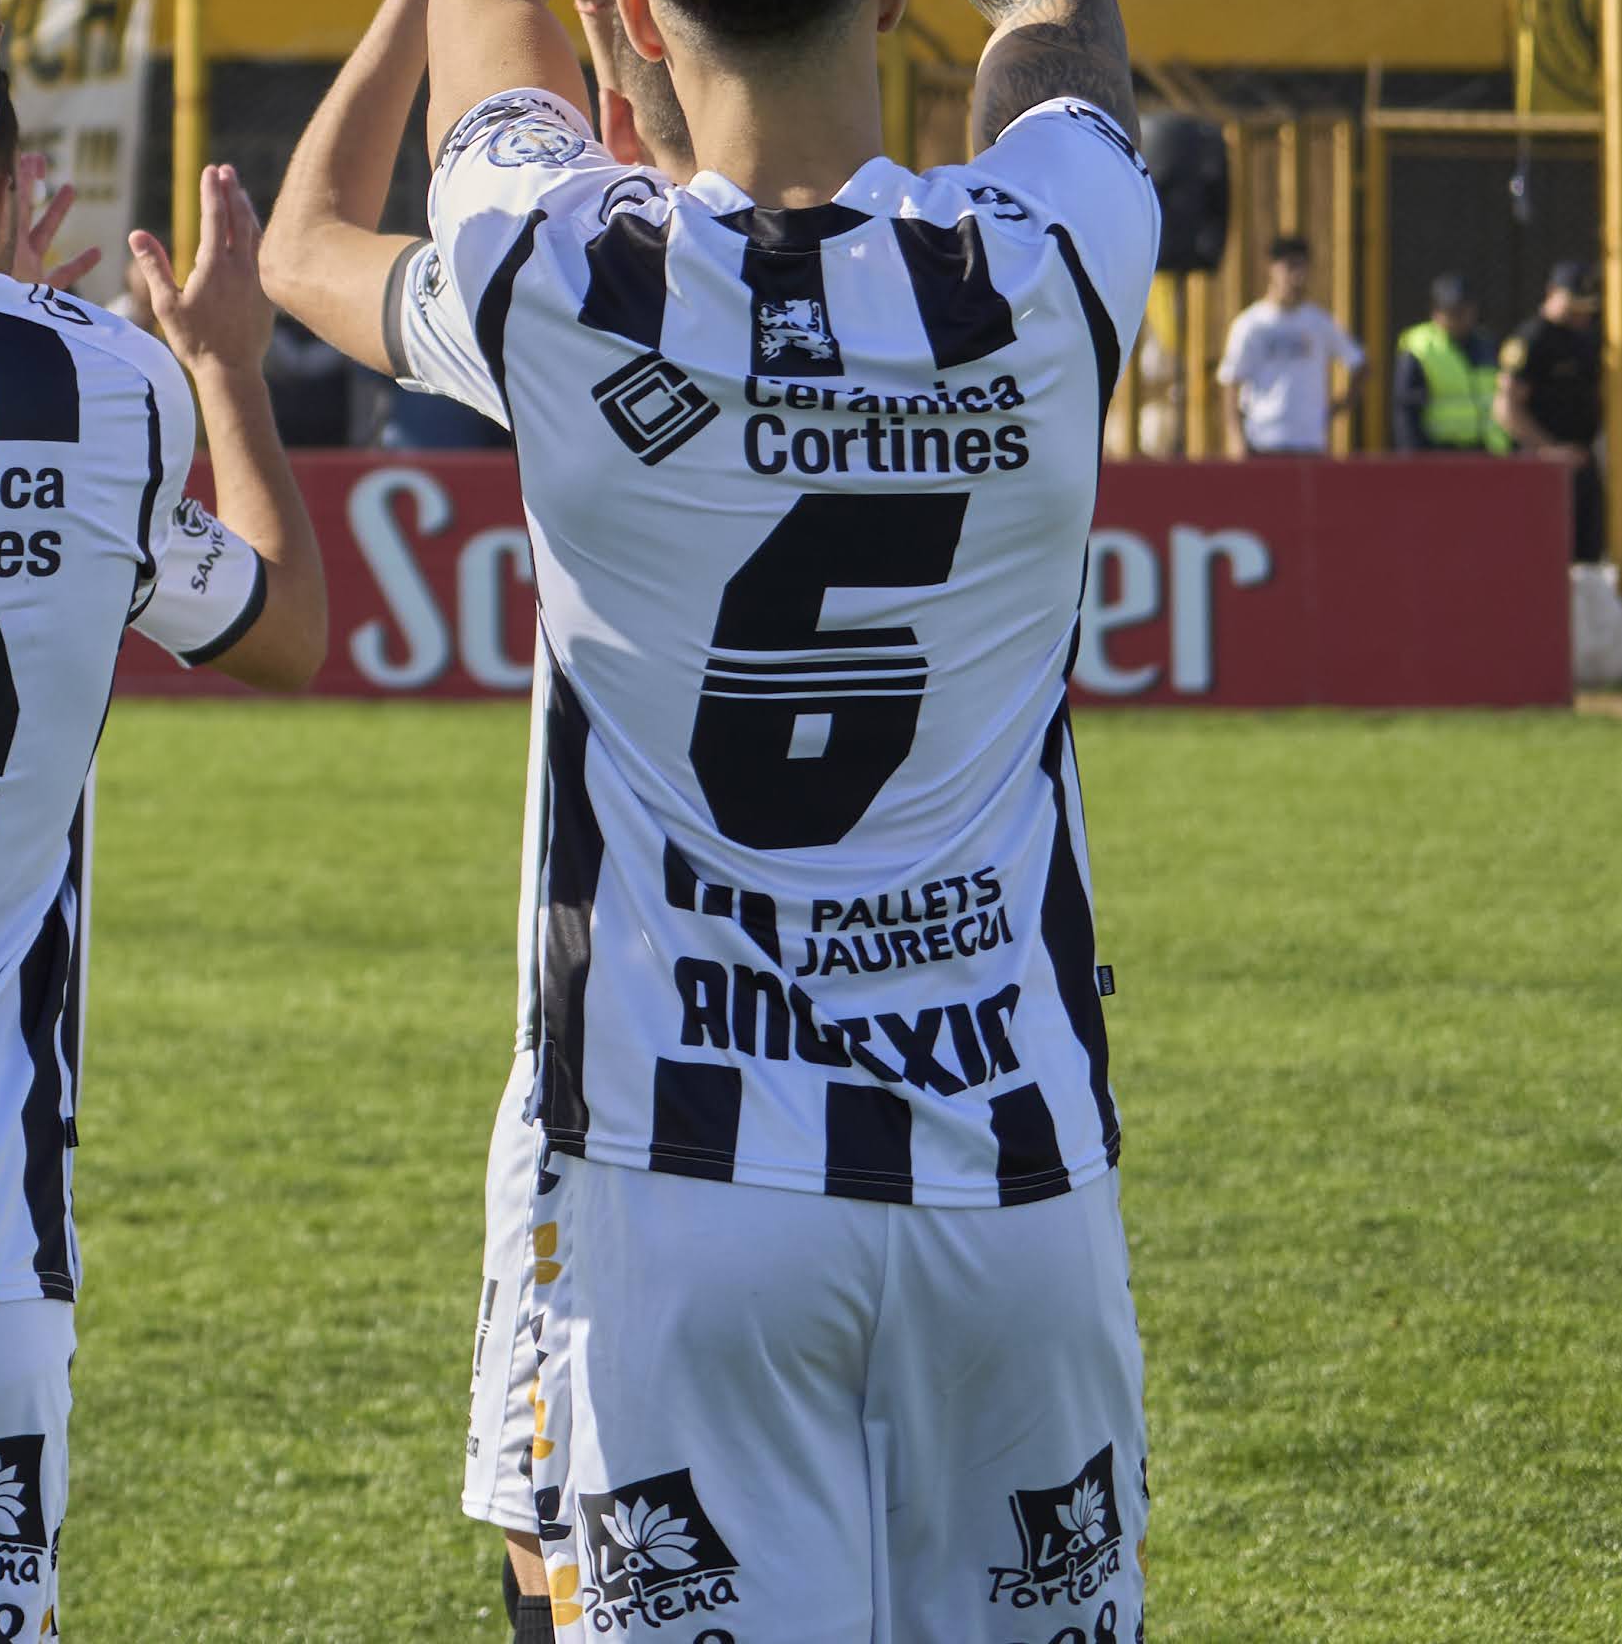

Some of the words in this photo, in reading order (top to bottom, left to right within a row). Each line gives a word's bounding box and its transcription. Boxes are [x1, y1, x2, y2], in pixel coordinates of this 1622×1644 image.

[744, 413, 1030, 475] Cortines
[688, 491, 971, 850] 6
[812, 866, 1002, 933] PALLETS
[796, 905, 1014, 976] JAUREGUI
[600, 1544, 655, 1584] La
[1037, 1532, 1089, 1568] La
